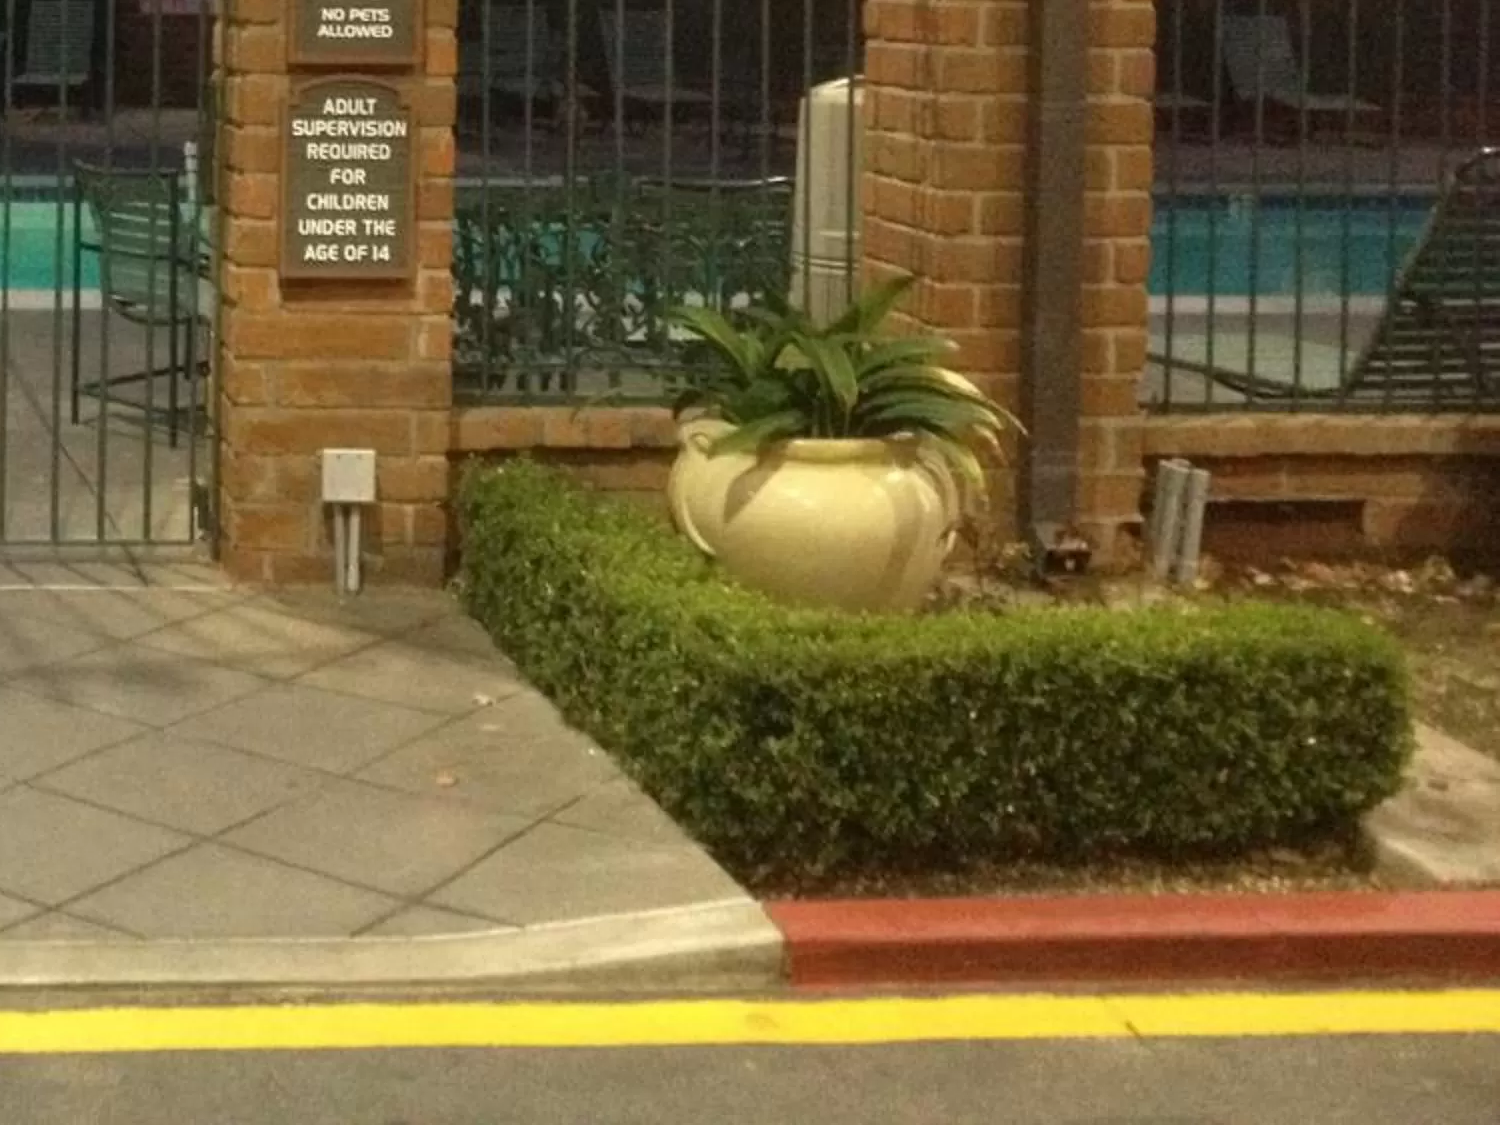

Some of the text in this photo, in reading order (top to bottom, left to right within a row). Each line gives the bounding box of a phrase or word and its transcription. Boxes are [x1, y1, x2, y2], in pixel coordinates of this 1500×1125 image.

[321, 7, 391, 21] NO PETS
[317, 24, 394, 37] ALLOWED
[322, 98, 377, 115] ADULT
[291, 119, 407, 136] SUPERVISION
[306, 142, 391, 159] REQUIRED
[329, 167, 367, 184] FOR
[306, 193, 389, 210] CHILDREN
[298, 218, 396, 235] UNDER THE
[303, 243, 390, 261] AGE OF 14
